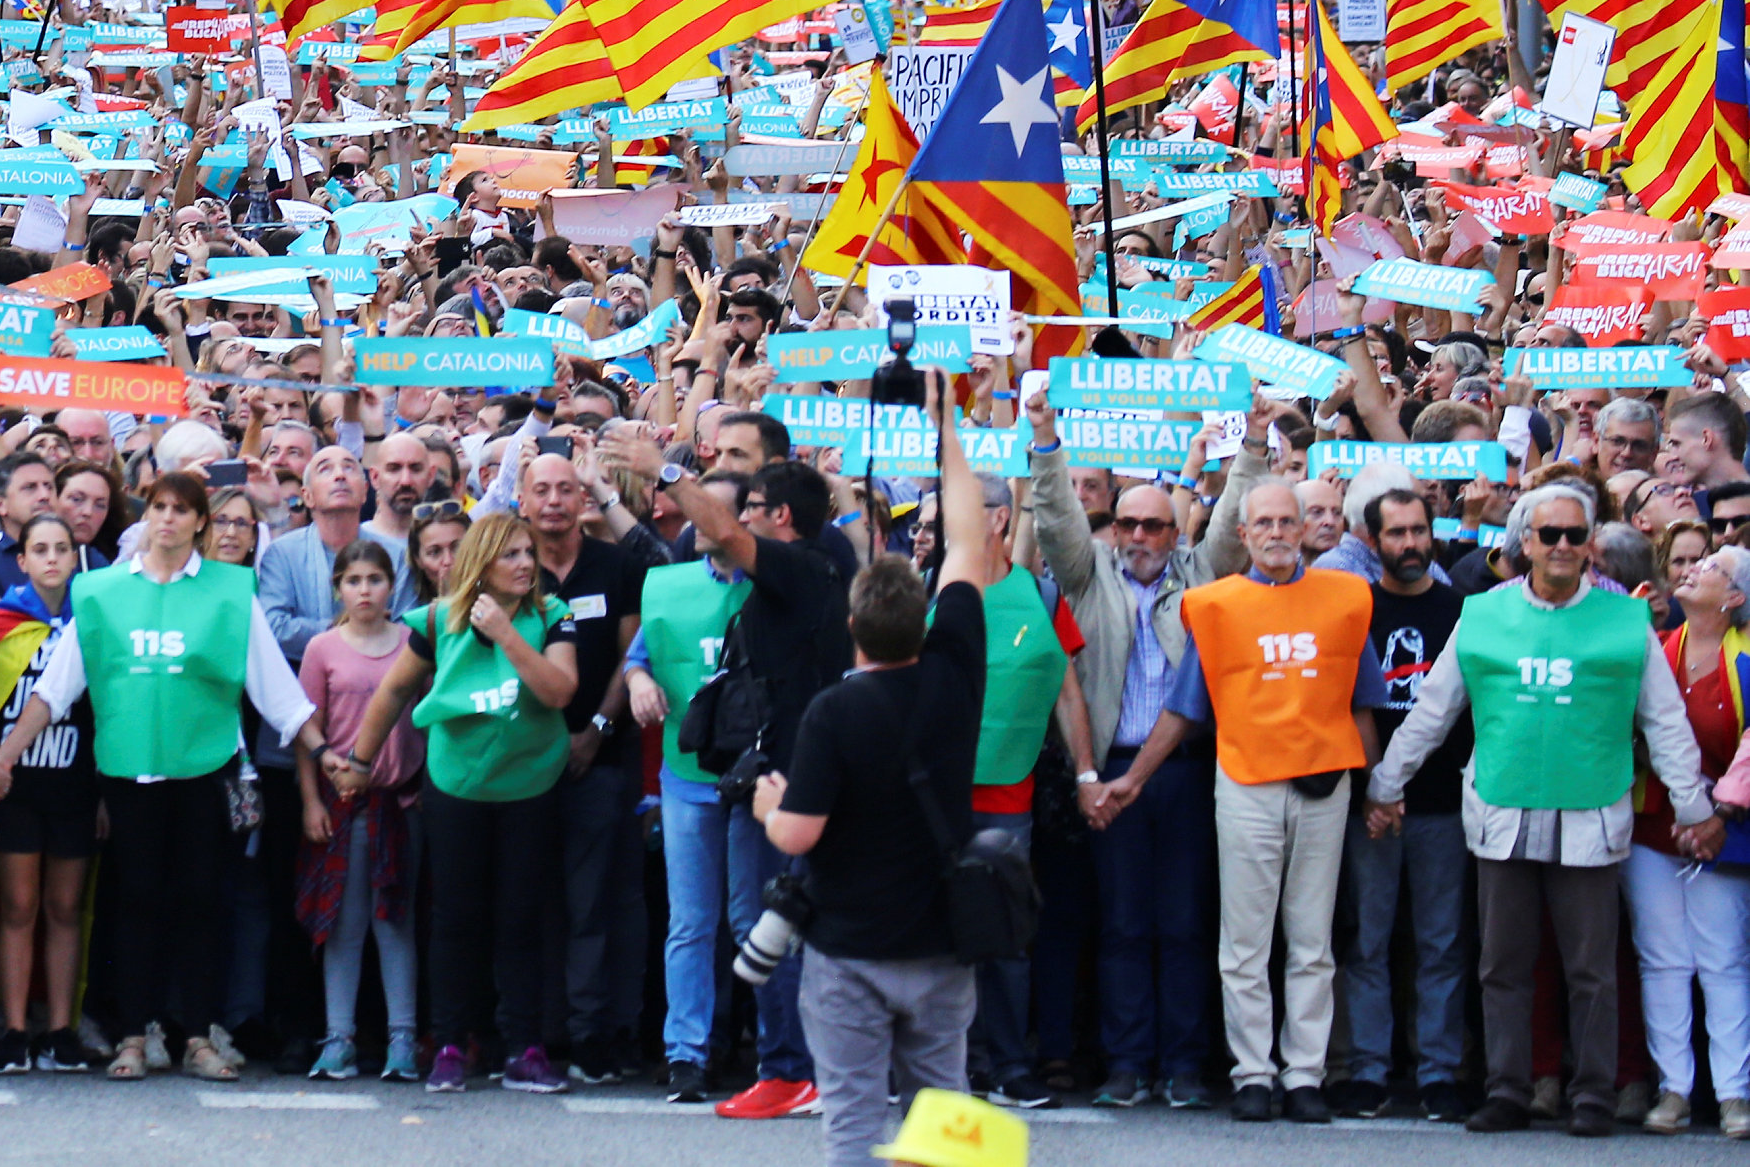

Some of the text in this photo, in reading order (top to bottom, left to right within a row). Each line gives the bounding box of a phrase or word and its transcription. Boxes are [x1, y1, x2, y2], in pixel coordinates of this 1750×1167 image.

[618, 102, 713, 124] LLIBERTAT
[739, 123, 797, 133] ATALONIA
[1120, 142, 1219, 156] LLIBERTAT
[1165, 174, 1259, 189] LLIBERTAT
[1557, 173, 1598, 200] LLIBERTAT
[1369, 264, 1480, 294] LLIBERTAT
[1596, 265, 1646, 278] BLICA
[1644, 252, 1704, 284] ARA!
[914, 295, 999, 309] IBERTAT
[913, 310, 997, 323] ORDIS!
[1593, 301, 1645, 338] ARA!
[75, 337, 155, 352] ATALONIA
[780, 341, 961, 366] HELP CATAONIA
[1219, 327, 1333, 379] LLIBERTAT
[363, 352, 545, 372] HELP CATALONIA
[1523, 349, 1669, 373] LLIBERTAT
[1071, 362, 1232, 392] LLIBERTAT
[1562, 375, 1603, 384] VOLEM
[1623, 373, 1658, 383] CASA
[75, 375, 181, 404] EUROPE
[1082, 394, 1100, 404] US
[1108, 394, 1157, 405] VOLEM
[1181, 395, 1219, 406] CASA
[862, 433, 1017, 458] LLIBETAT
[1324, 444, 1479, 467] LLIBERTAT
[1146, 454, 1182, 465] CASA
[129, 630, 185, 657] 11S
[1257, 633, 1317, 662] 11S
[1517, 658, 1573, 687] 11S
[470, 679, 518, 711] 11S
